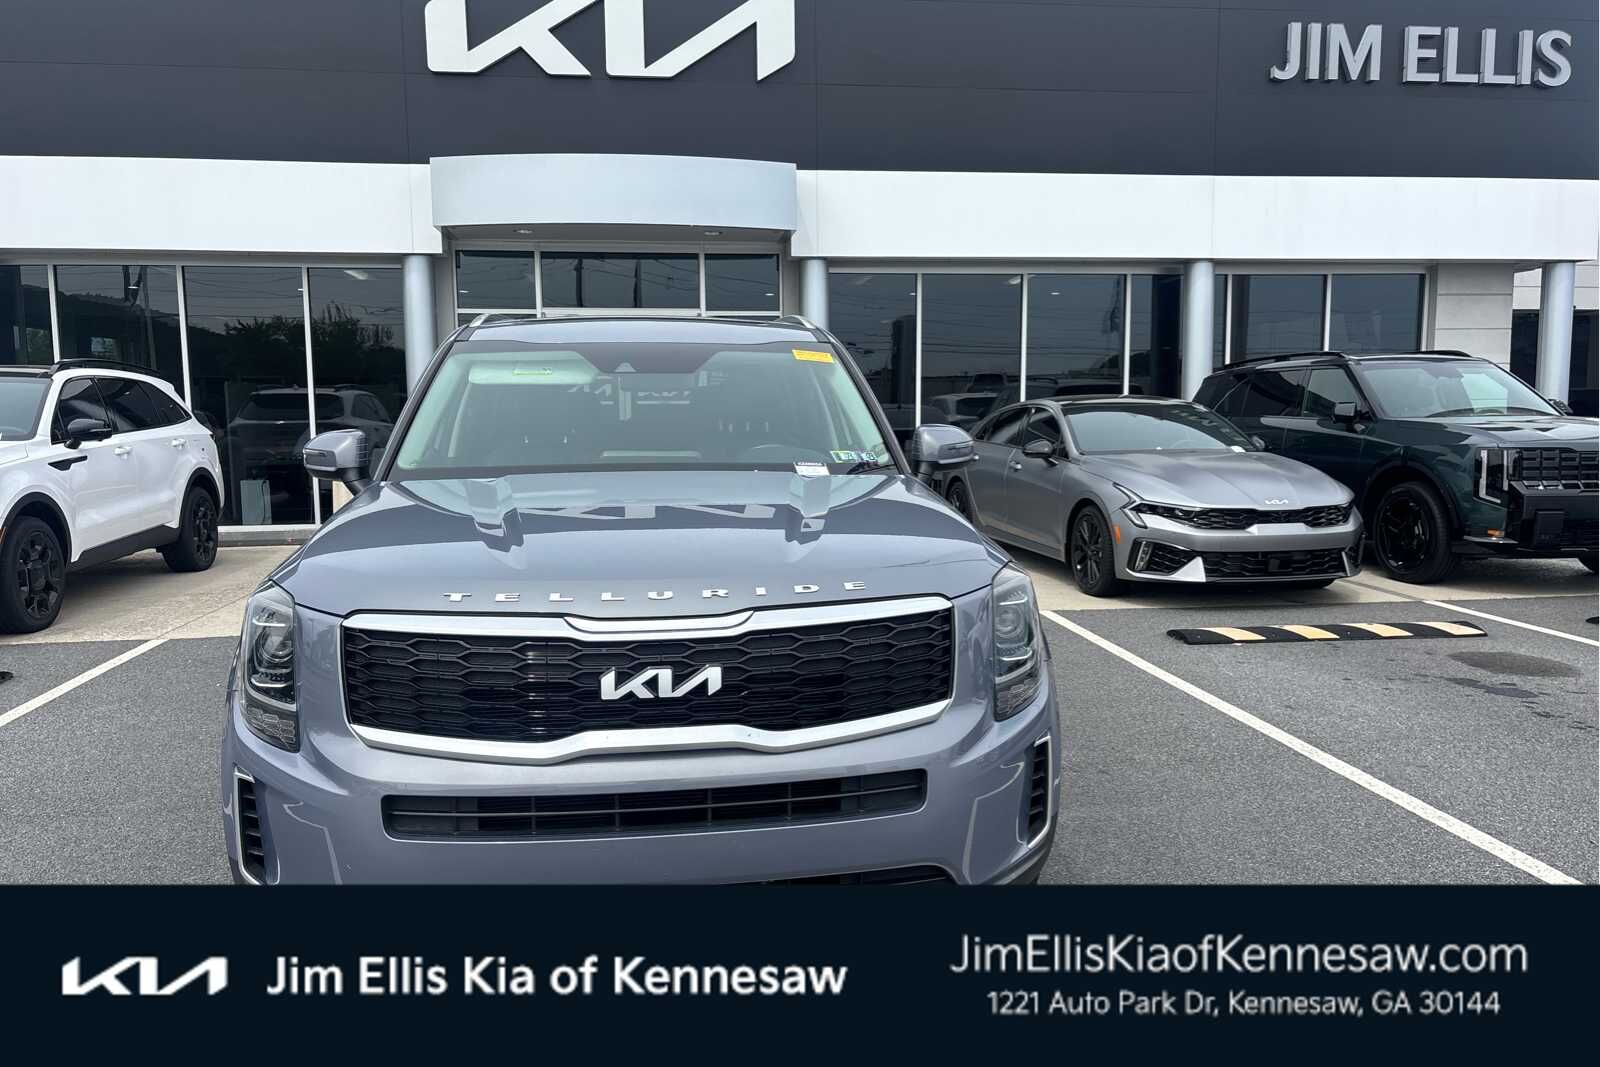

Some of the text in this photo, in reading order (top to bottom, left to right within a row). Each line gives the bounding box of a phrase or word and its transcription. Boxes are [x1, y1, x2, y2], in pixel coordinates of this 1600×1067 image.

[424, 0, 796, 80] KIA
[1270, 22, 1572, 87] JIM ELLIS
[444, 581, 867, 603] TELLURIDE
[600, 665, 723, 701] KIA
